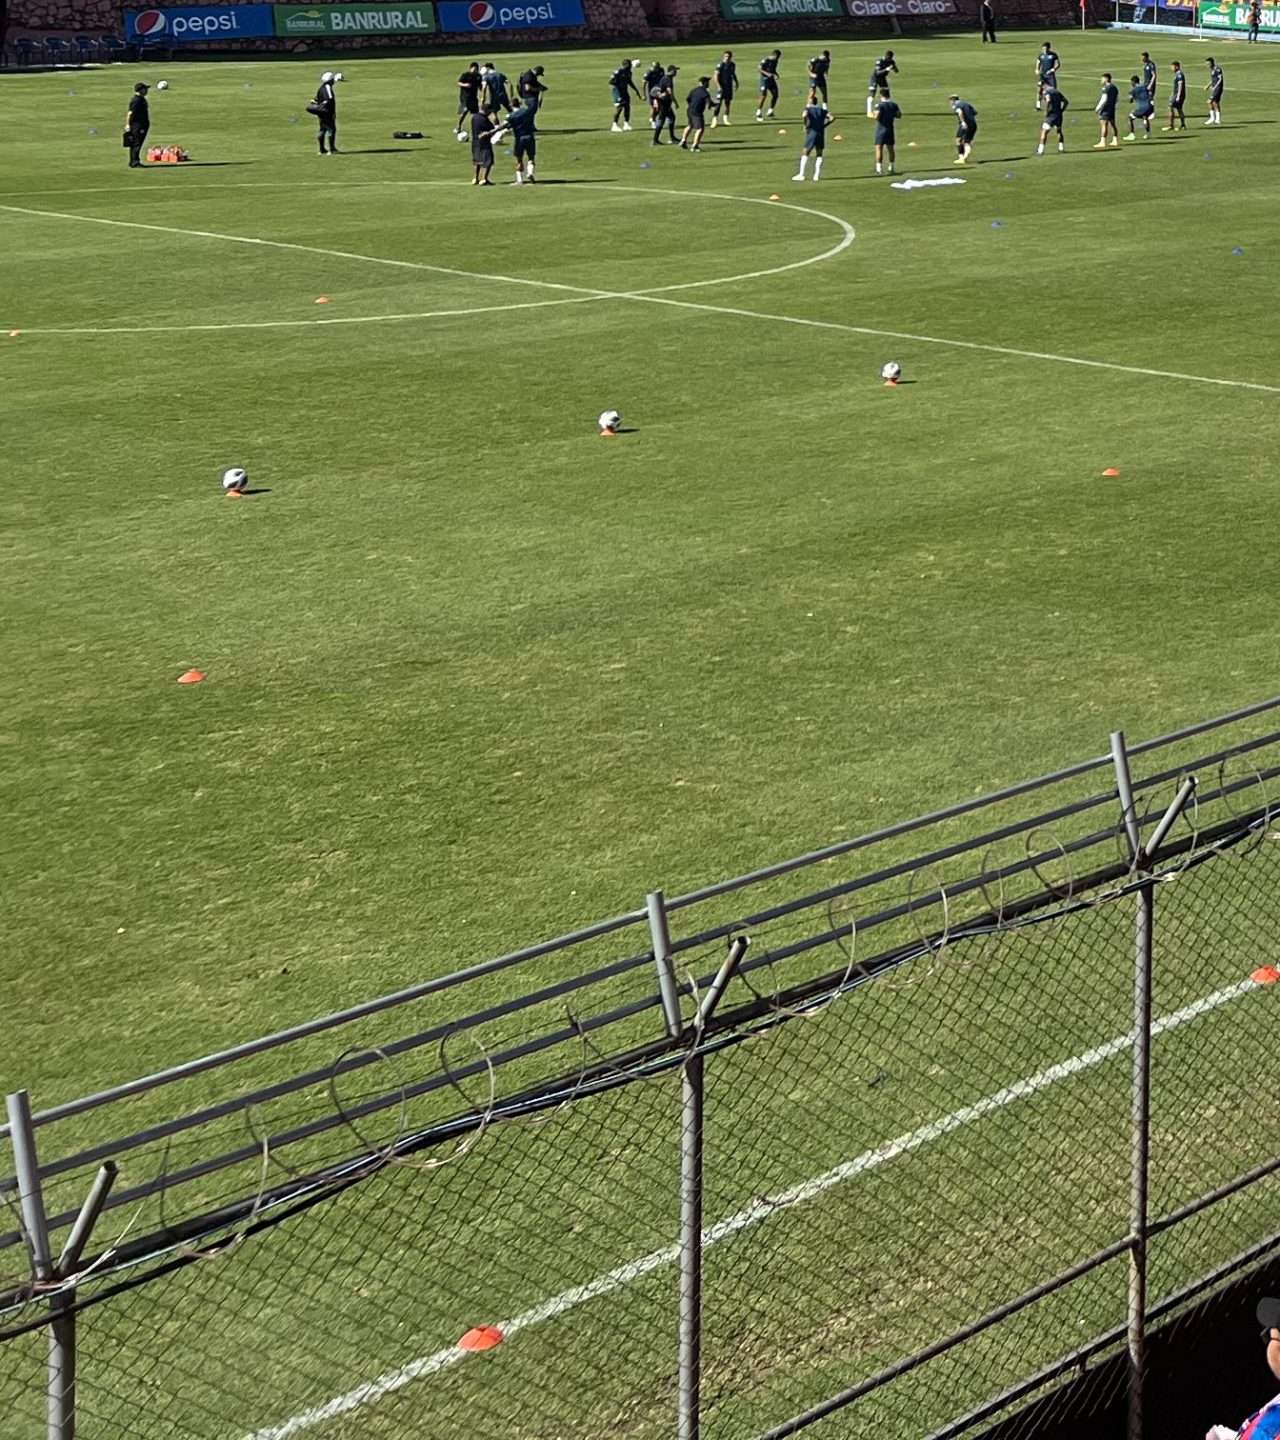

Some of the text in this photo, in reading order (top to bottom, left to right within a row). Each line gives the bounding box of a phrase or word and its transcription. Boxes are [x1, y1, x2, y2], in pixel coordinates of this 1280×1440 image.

[172, 10, 241, 36] pepsi
[331, 10, 429, 31] BANRURAL
[500, 2, 555, 25] pepsi
